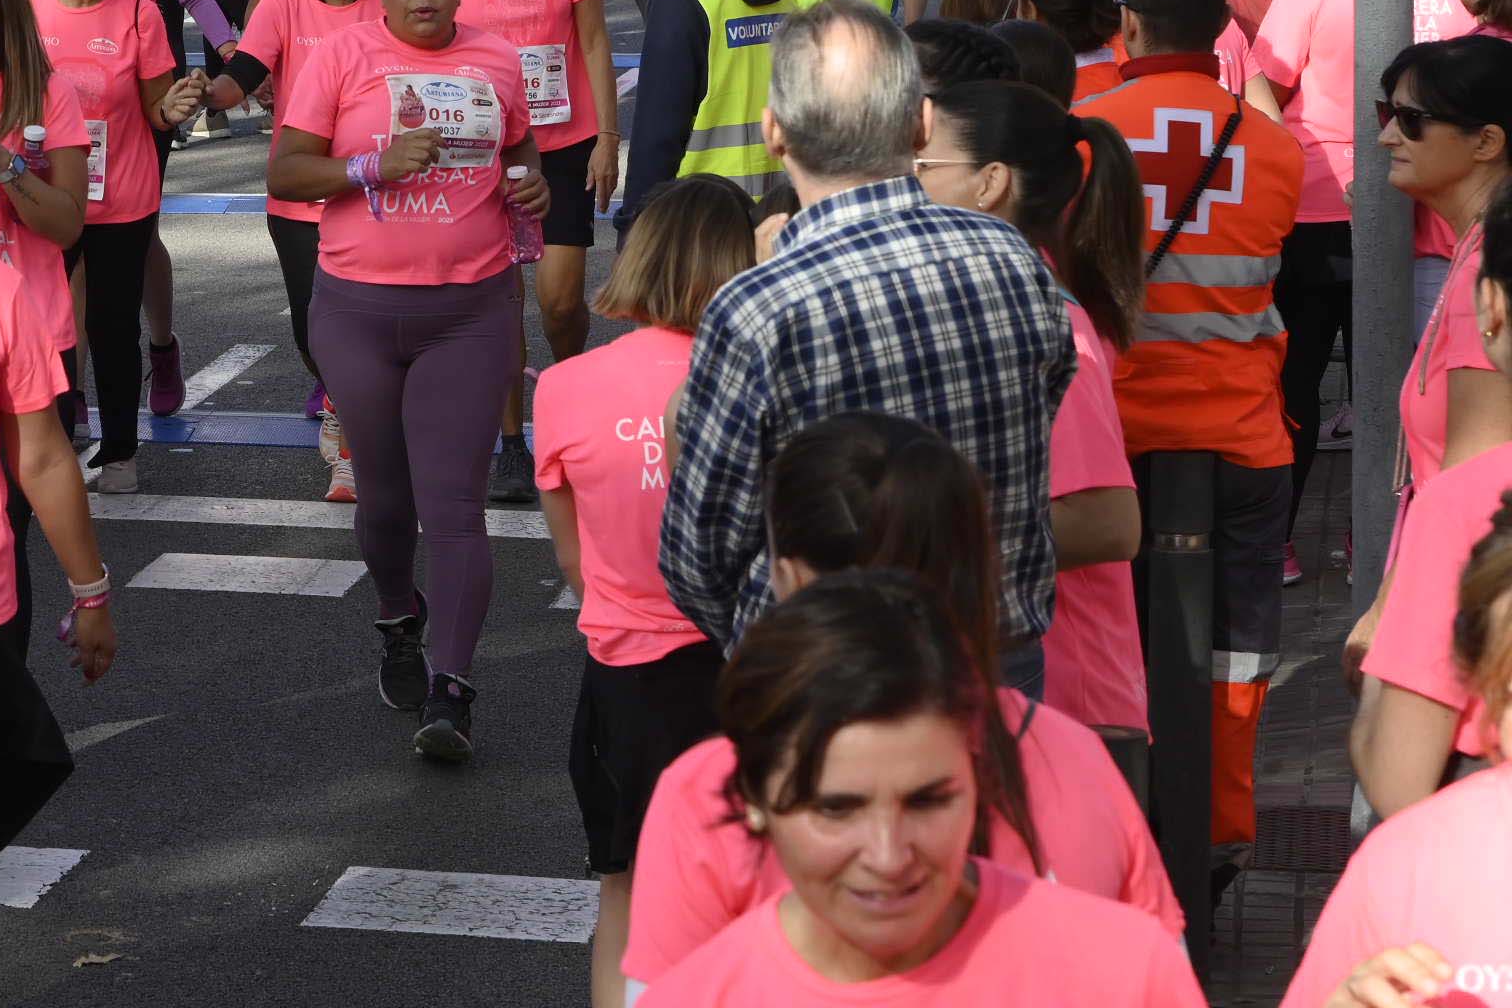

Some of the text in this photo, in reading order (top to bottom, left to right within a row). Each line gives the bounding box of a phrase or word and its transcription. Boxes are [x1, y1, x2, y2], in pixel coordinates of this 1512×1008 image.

[728, 14, 782, 41] VOLUNTA
[423, 87, 465, 97] ASTURIANA
[429, 108, 465, 123] 016
[368, 191, 451, 214] UMA
[643, 442, 663, 464] D
[1455, 964, 1512, 994] OYS
